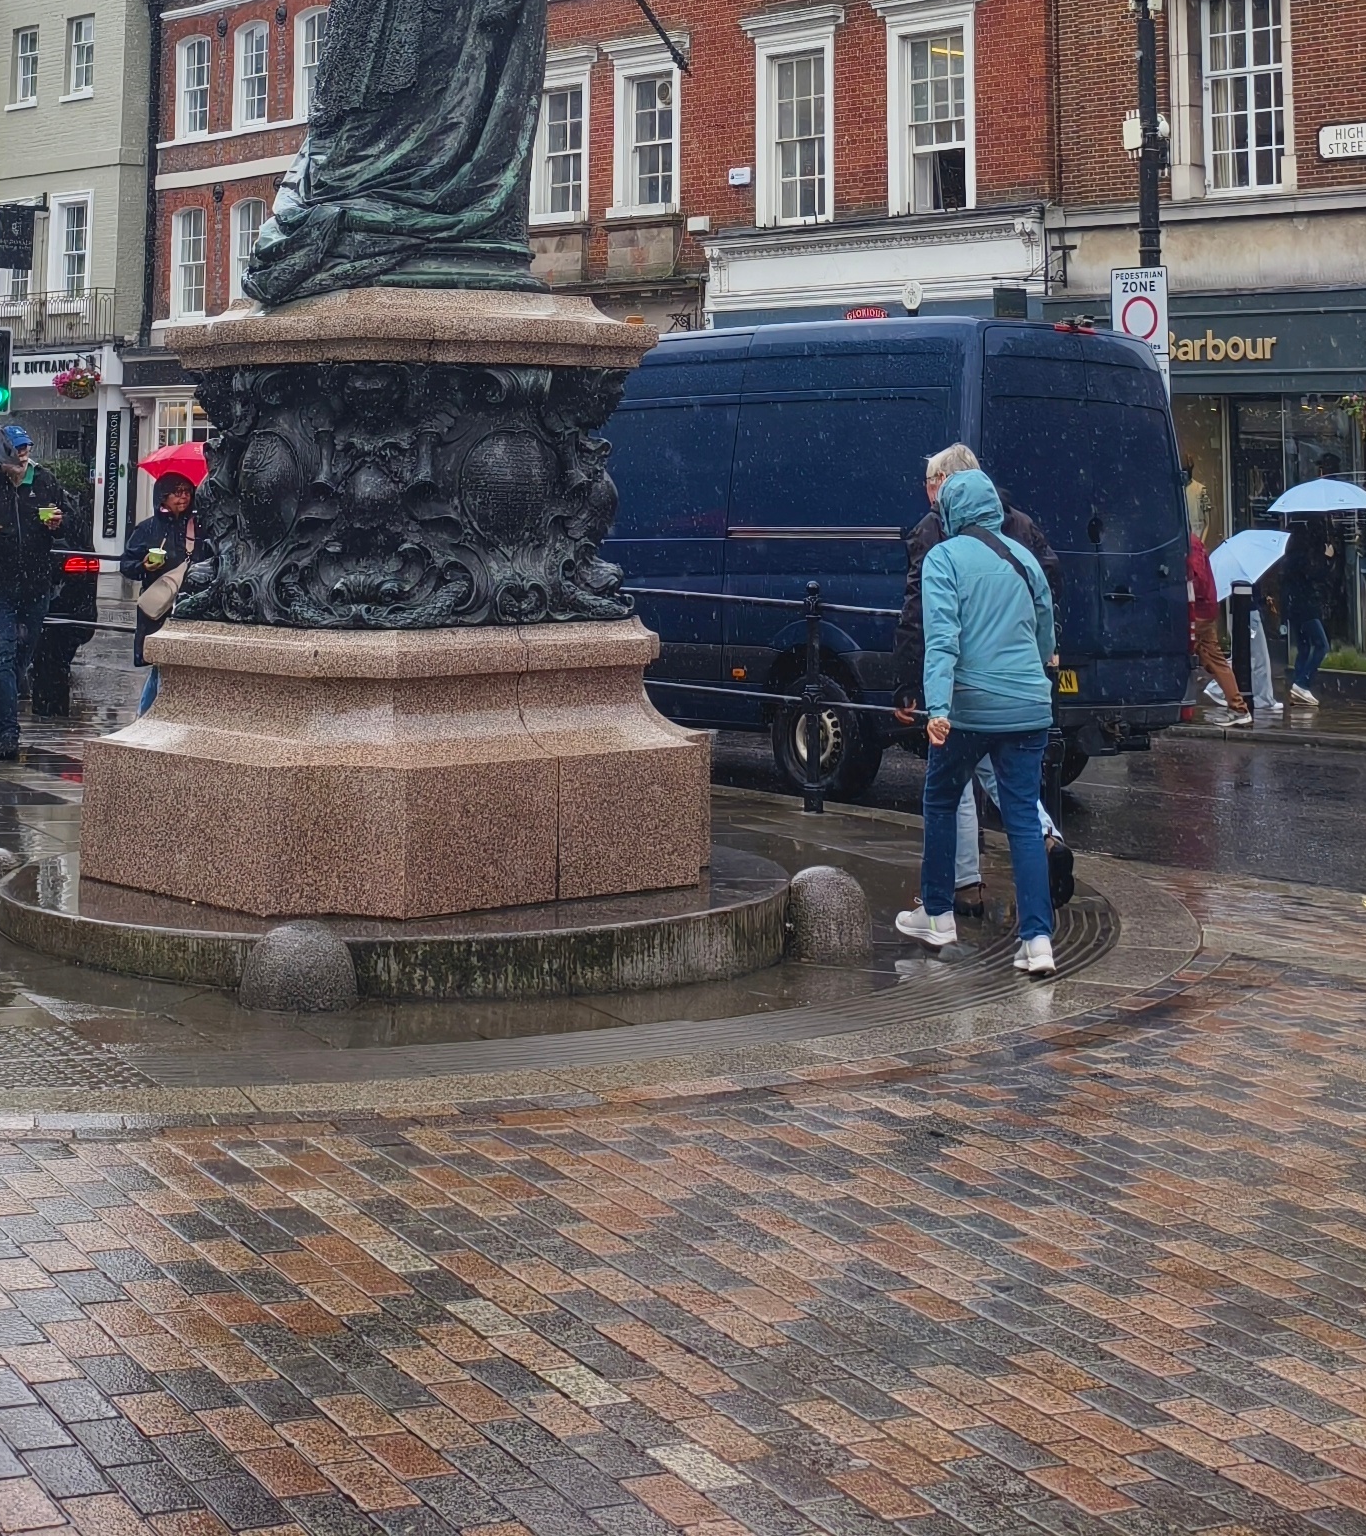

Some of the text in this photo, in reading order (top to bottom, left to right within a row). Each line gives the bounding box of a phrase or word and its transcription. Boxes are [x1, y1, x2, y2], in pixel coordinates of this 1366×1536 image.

[1335, 127, 1364, 141] HIGH
[1115, 271, 1164, 281] PEDESTRIAN
[1122, 281, 1156, 293] ZONE
[1169, 329, 1278, 361] Barbour
[24, 358, 80, 376] ENTRANCE
[107, 413, 119, 527] MACDONALD WINDSOR
